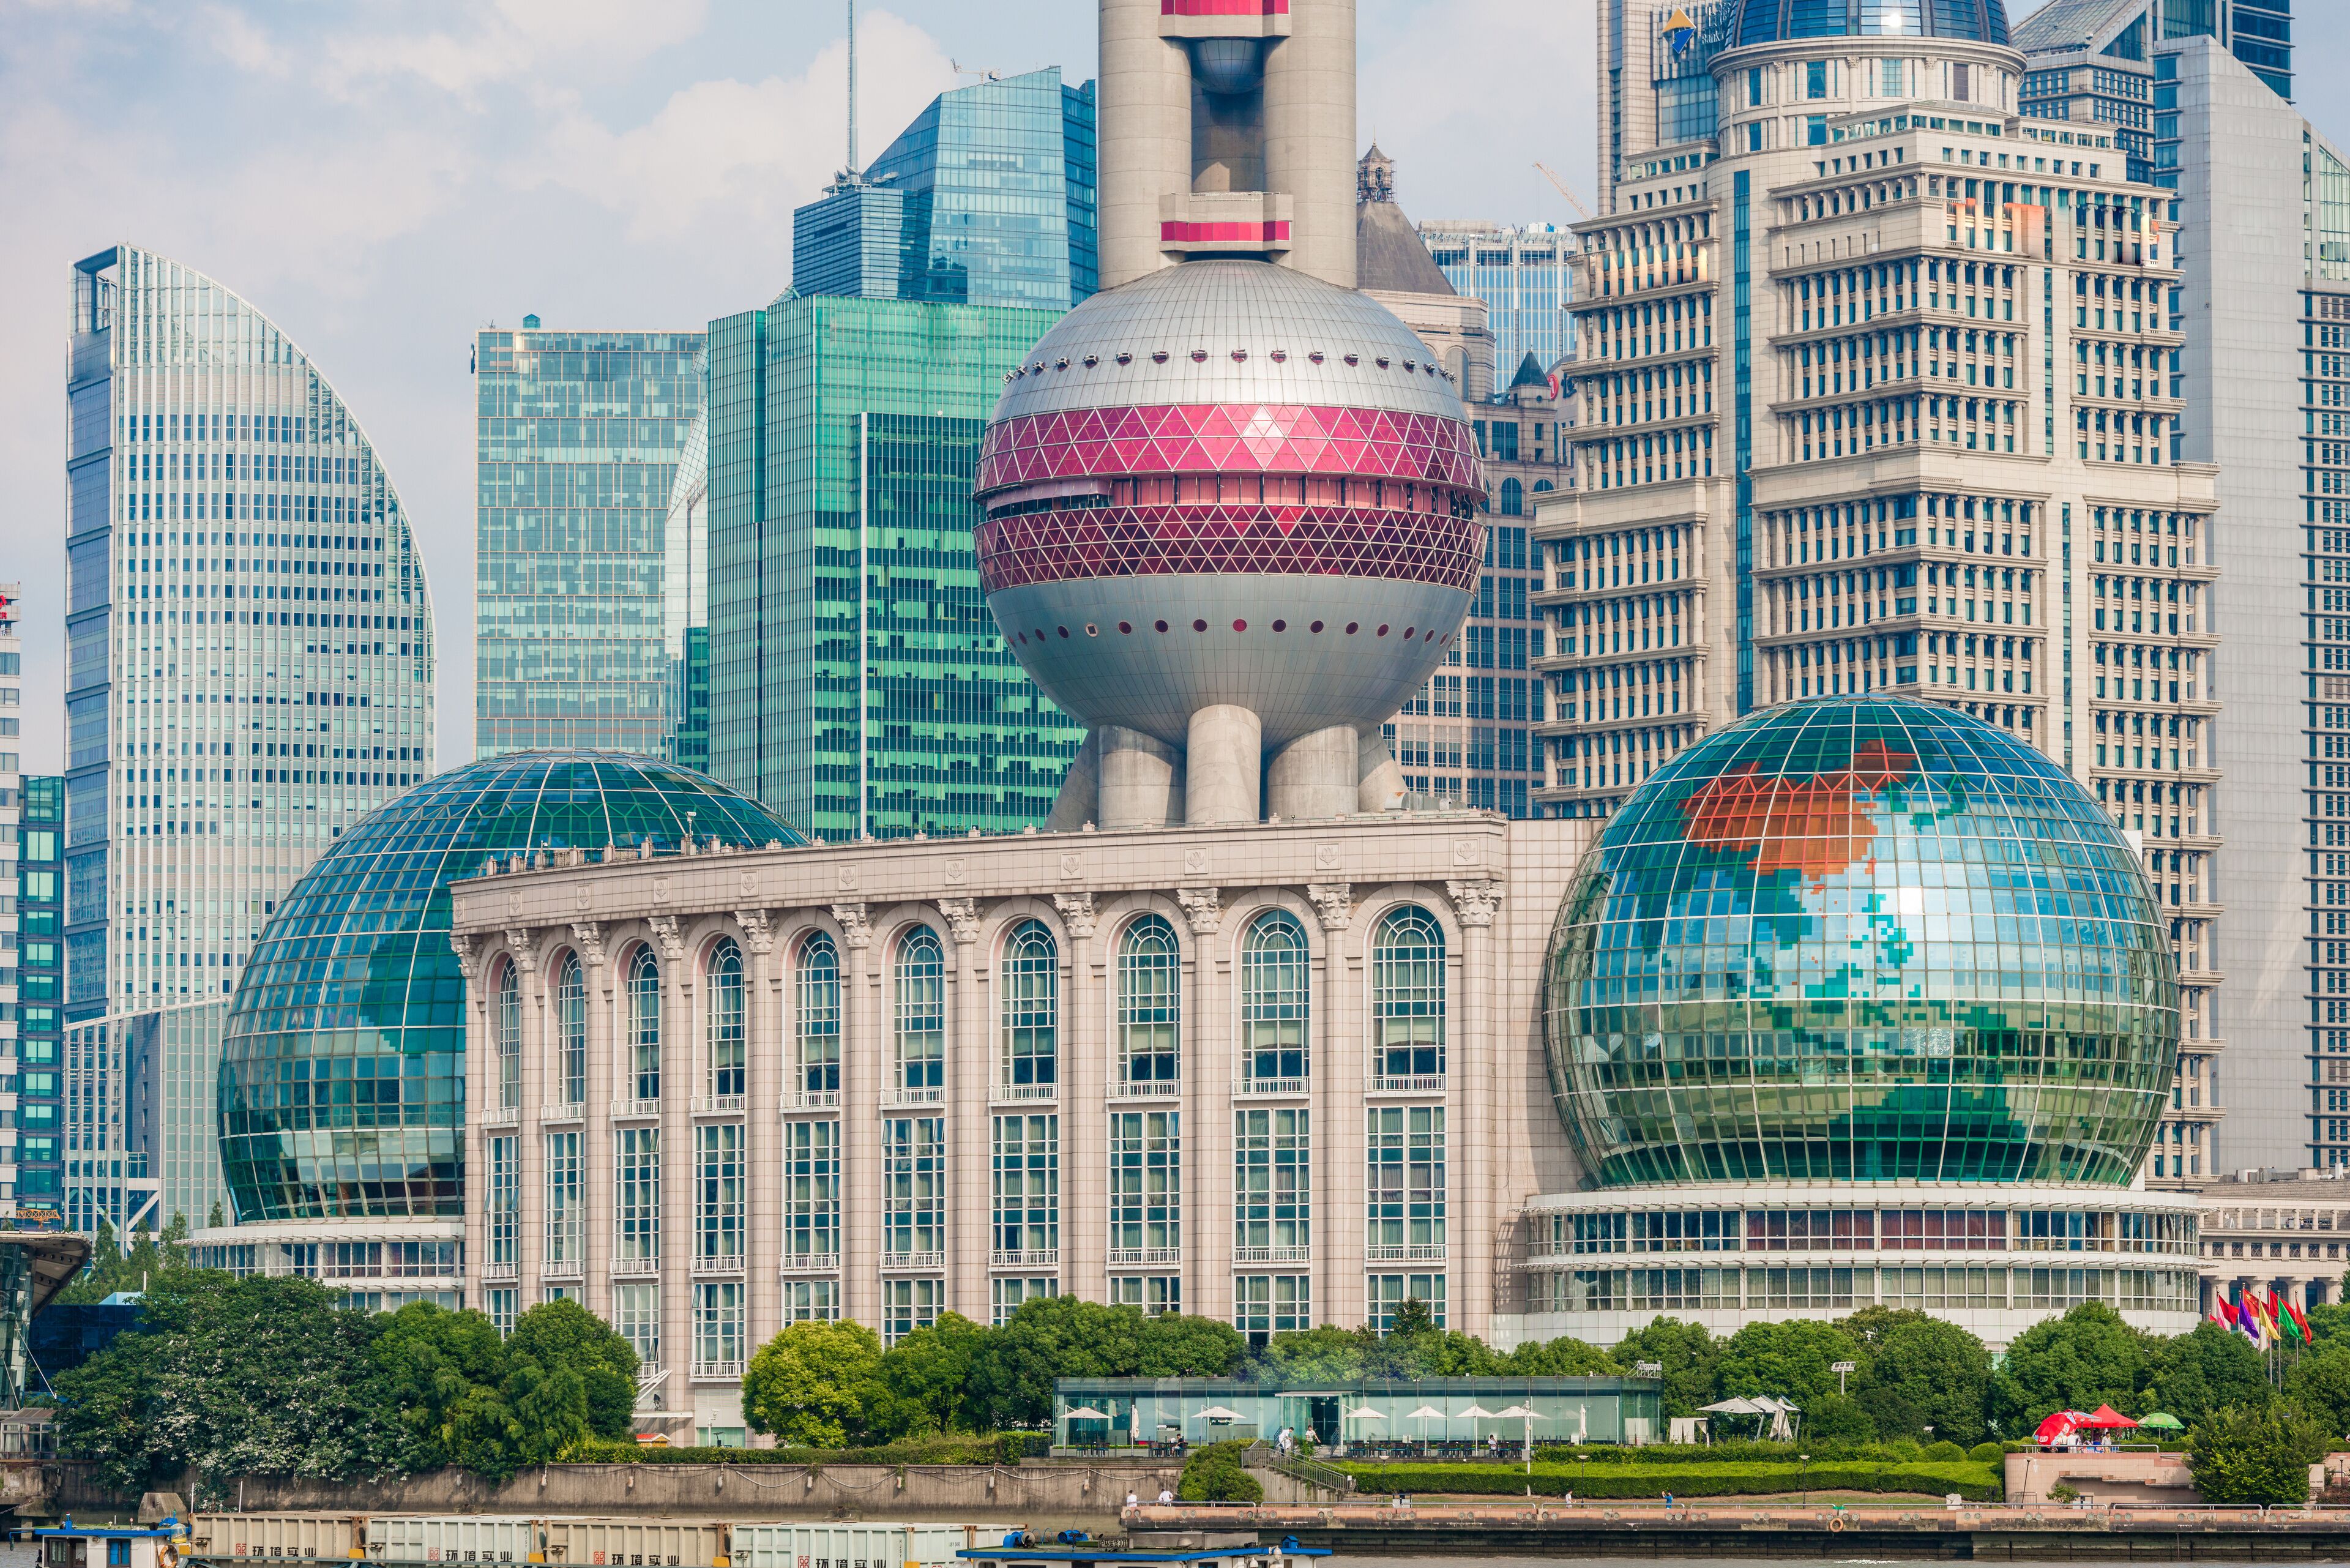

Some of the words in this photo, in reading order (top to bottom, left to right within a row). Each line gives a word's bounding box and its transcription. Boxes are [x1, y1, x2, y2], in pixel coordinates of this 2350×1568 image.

[1702, 30, 1721, 45] Bank
[252, 1545, 316, 1558] 环境实业
[446, 1550, 512, 1562] 环境实业
[611, 1553, 680, 1567] 环境实业
